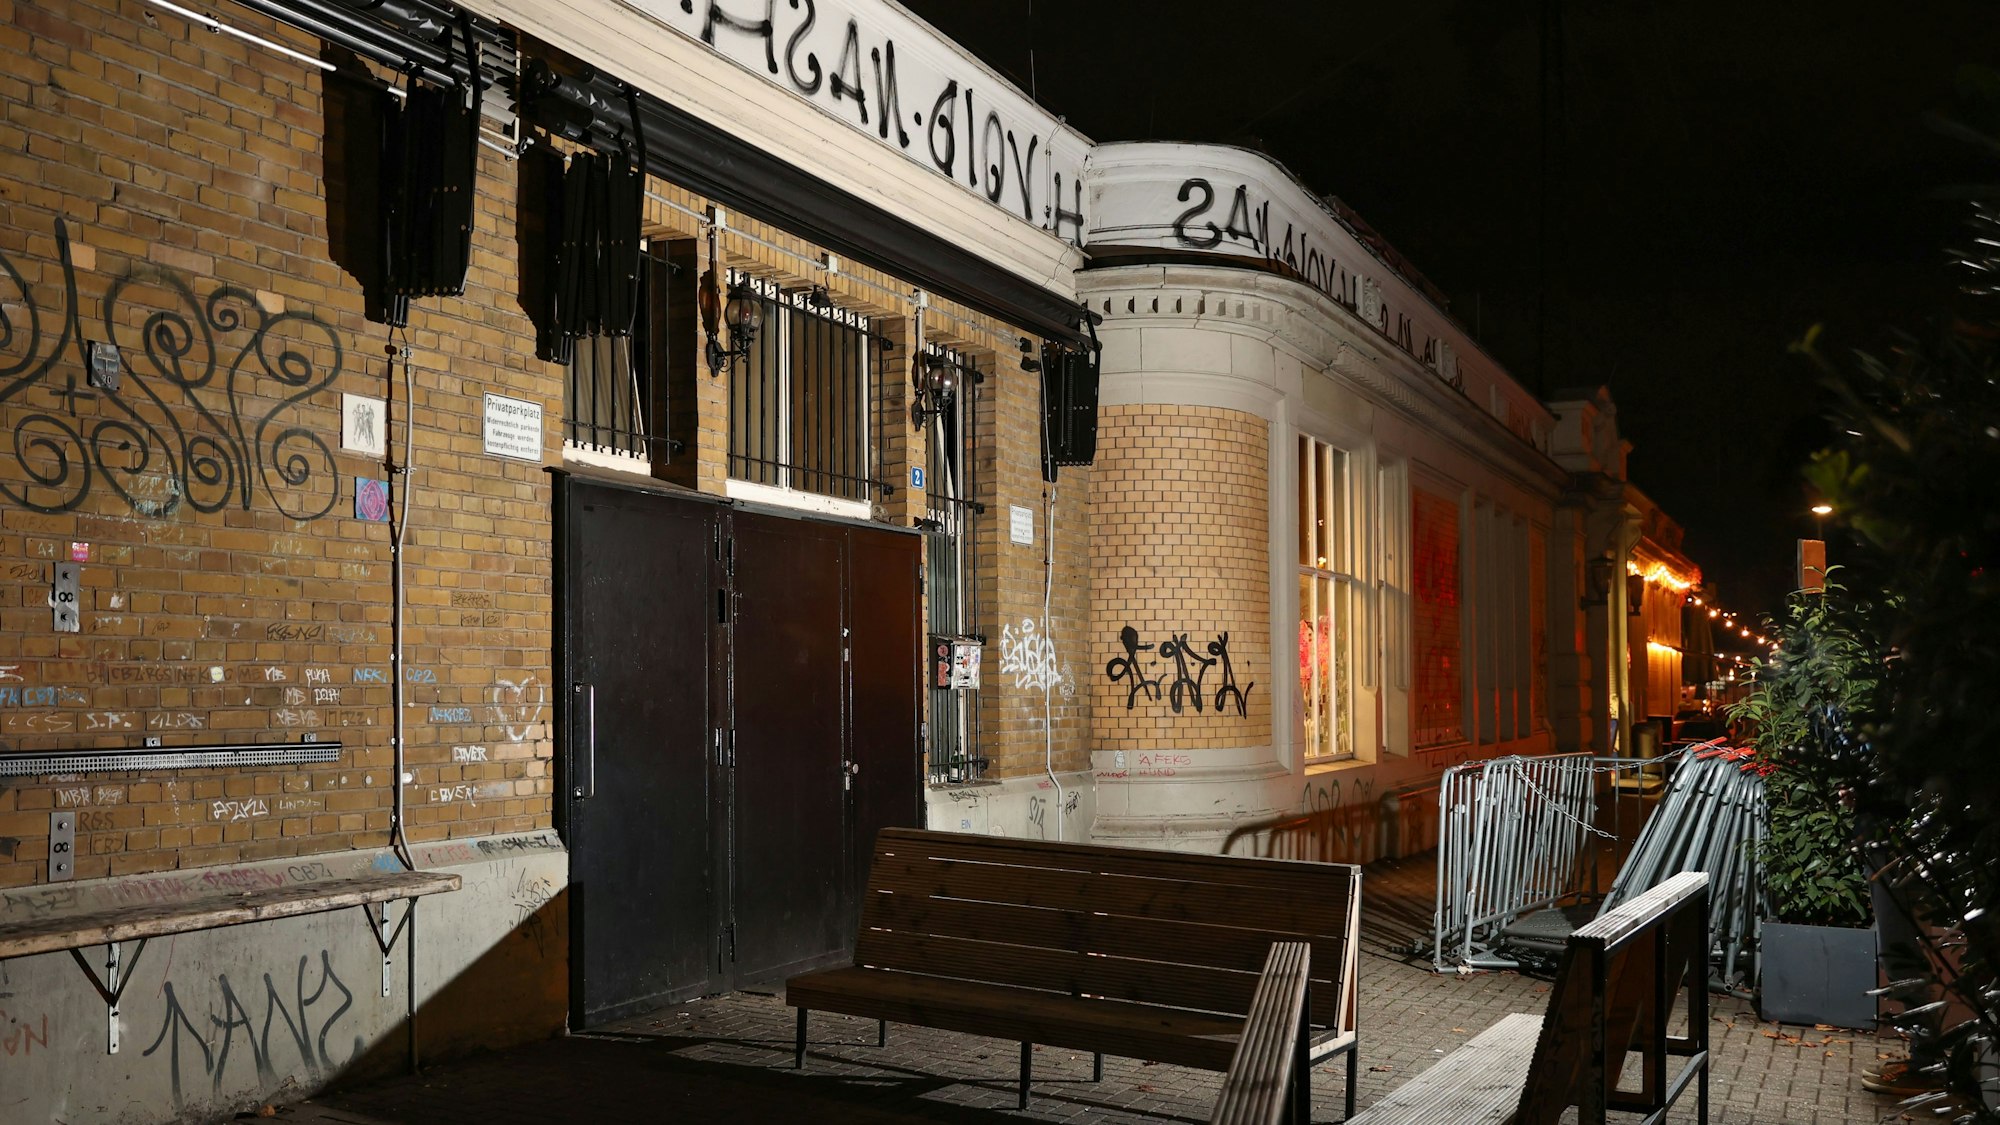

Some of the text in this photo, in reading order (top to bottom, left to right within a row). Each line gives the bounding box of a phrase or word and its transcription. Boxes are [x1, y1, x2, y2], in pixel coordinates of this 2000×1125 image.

[487, 397, 540, 419] Privatparkplatz
[487, 416, 519, 428] Widerrechtlich
[493, 428, 515, 440] Fahrzeuge
[487, 439, 519, 453] kostenpflichtig
[915, 470, 921, 485] 2
